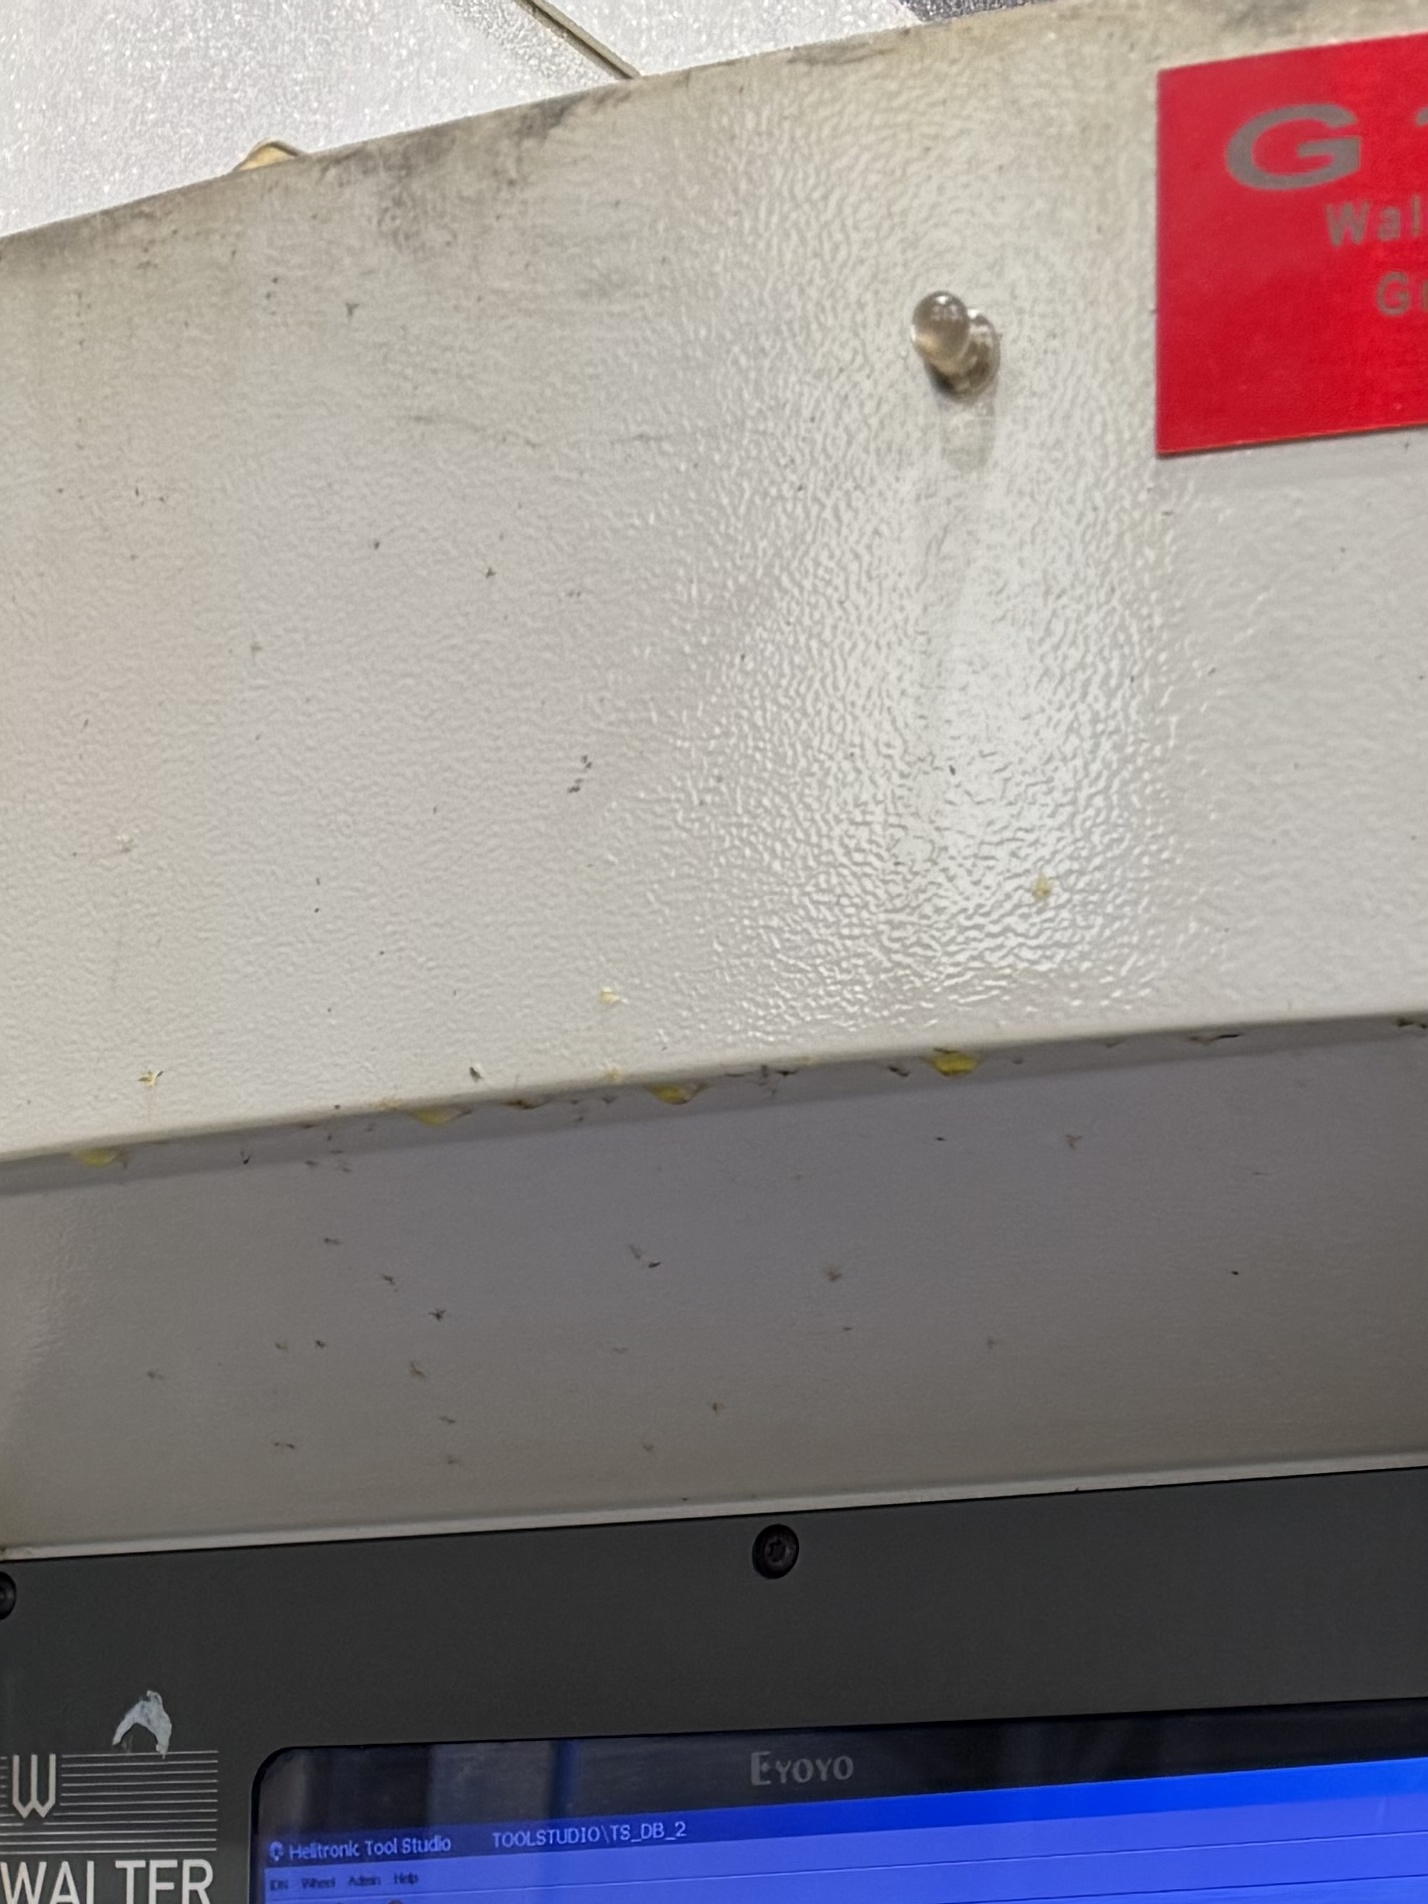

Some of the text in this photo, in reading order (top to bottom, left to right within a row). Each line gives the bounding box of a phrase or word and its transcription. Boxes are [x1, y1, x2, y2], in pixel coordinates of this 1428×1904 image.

[289, 1839, 360, 1861] Helitronic
[366, 1839, 398, 1857] Tool
[401, 1835, 452, 1855] Studio
